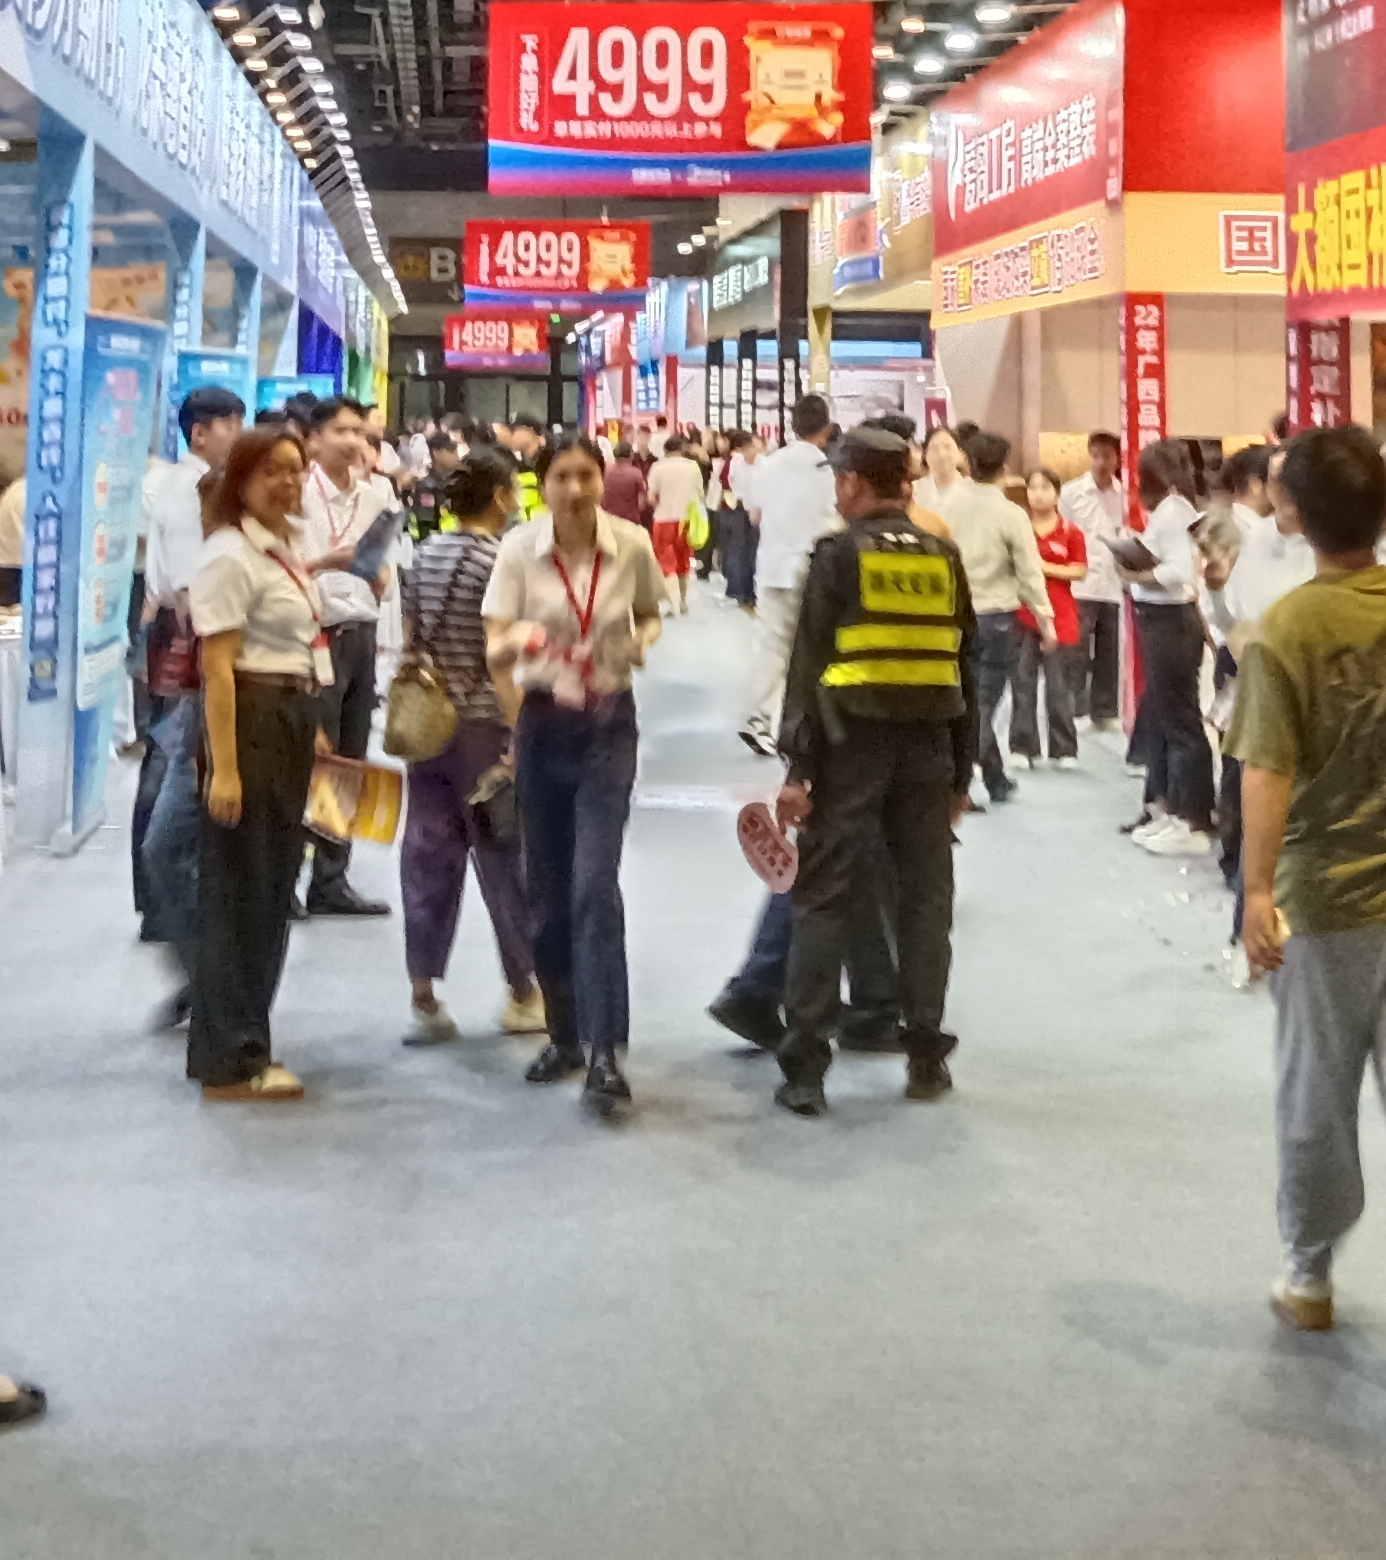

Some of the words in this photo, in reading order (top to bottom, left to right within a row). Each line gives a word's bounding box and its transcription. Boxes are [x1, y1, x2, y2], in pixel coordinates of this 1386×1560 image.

[551, 25, 728, 118] 4999
[495, 231, 581, 276] 4999
[1219, 212, 1285, 273] 国
[462, 320, 510, 347] 4999
